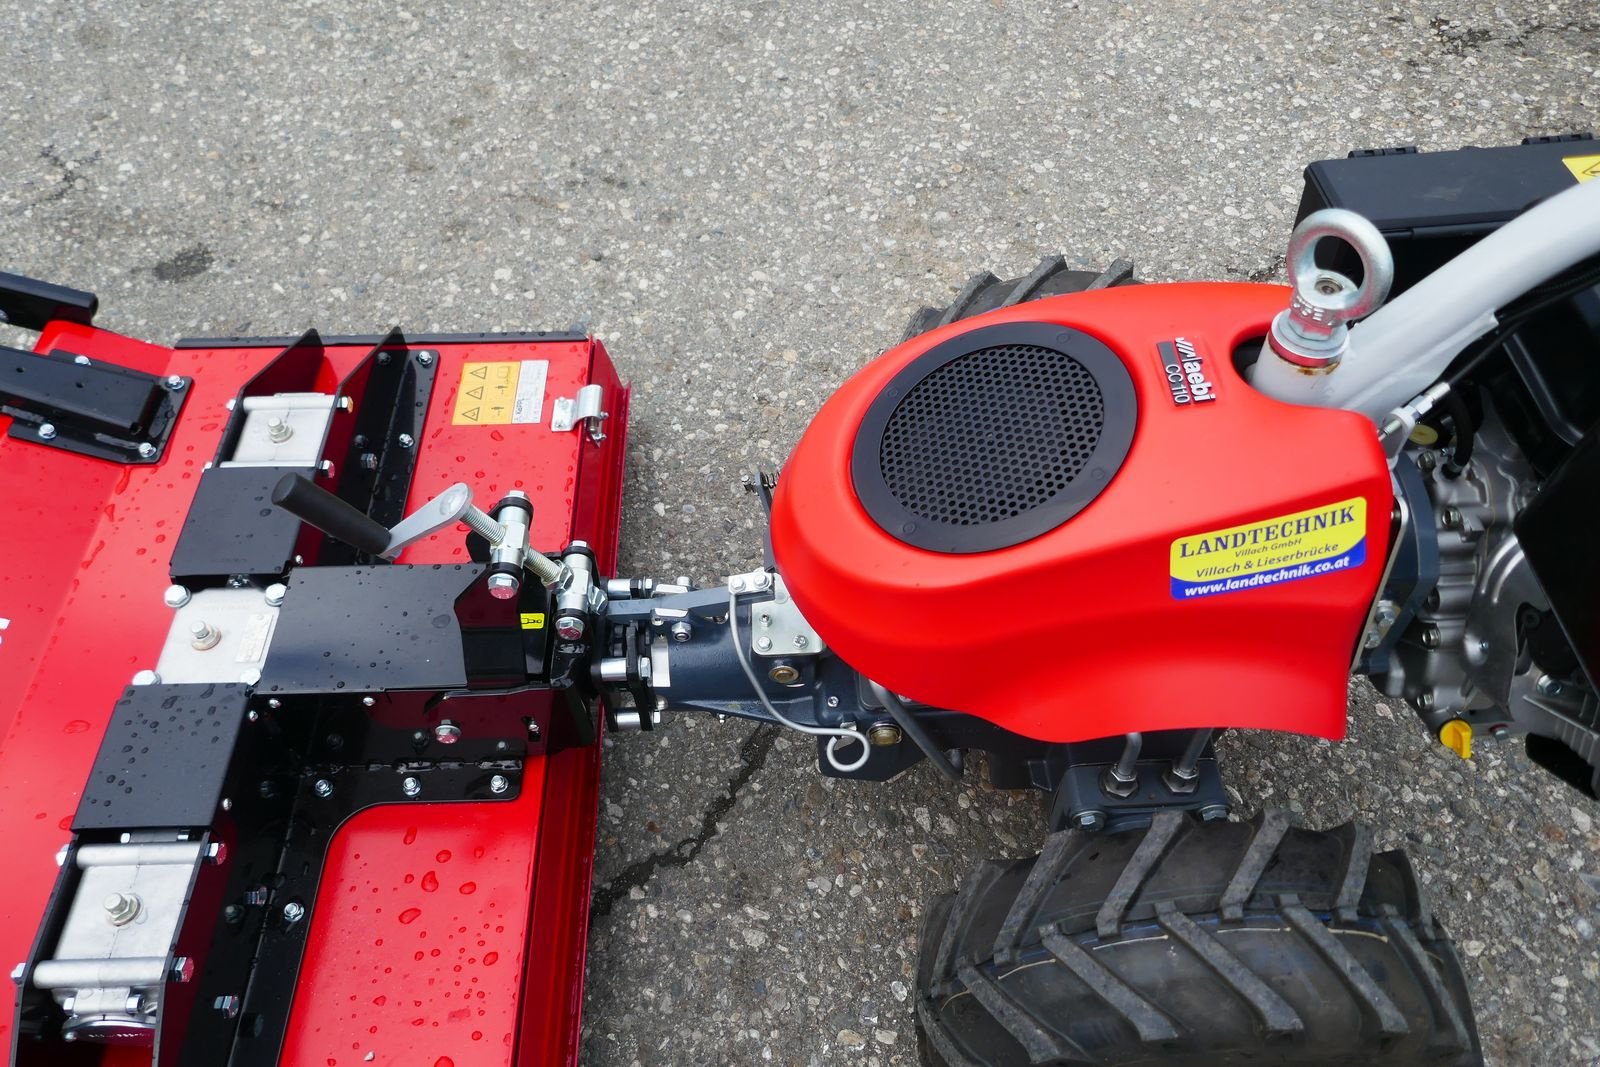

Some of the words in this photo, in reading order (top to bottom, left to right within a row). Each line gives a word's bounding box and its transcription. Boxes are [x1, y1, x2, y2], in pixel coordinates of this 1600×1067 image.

[1165, 364, 1190, 403] CC110
[1183, 361, 1216, 401] aebi
[1179, 505, 1355, 558] LANDTECHNIK
[1235, 541, 1268, 558] Villach
[1271, 538, 1302, 553] GmbH
[1185, 556, 1350, 597] www.landtechnik.co.at
[1196, 561, 1240, 578] Villach
[1243, 558, 1254, 569] &
[1257, 543, 1339, 567] Lieserbrücke
